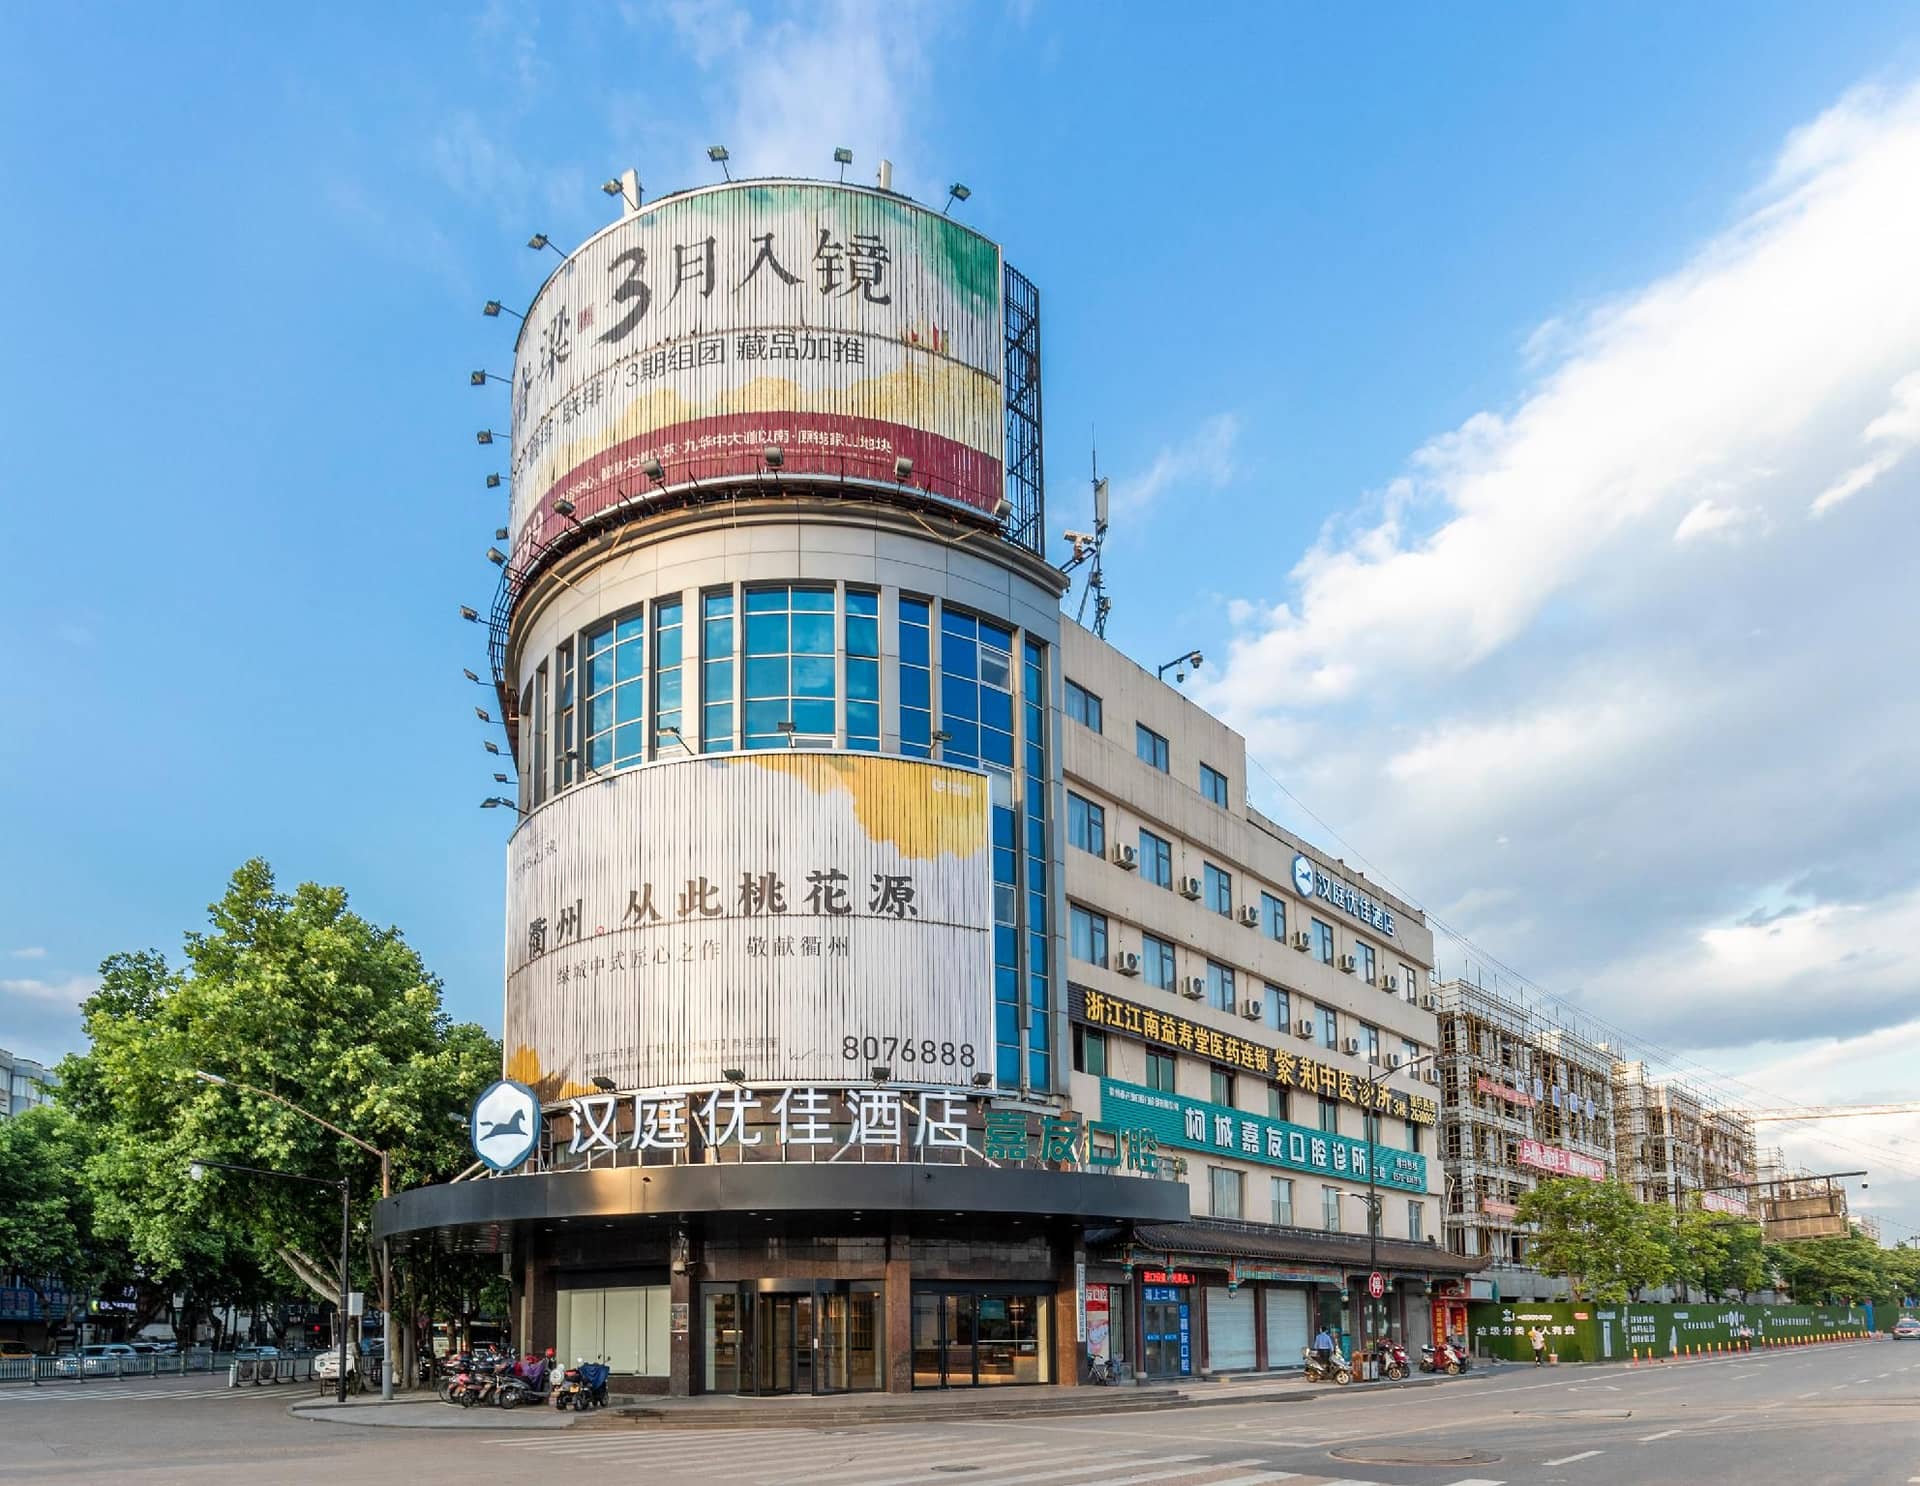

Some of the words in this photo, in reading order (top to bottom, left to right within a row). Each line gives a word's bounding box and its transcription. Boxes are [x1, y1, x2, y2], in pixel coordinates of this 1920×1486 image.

[591, 228, 892, 348] 3月入镜
[736, 331, 866, 366] 藏品加推
[621, 867, 919, 925] 从此桃花源
[1315, 870, 1395, 938] 汉庭优佳酒店
[746, 934, 849, 959] 敬献衢州
[841, 1034, 977, 1069] 8076888
[1085, 991, 1269, 1073] 浙江江南益寿堂医药连锁
[1274, 1047, 1392, 1114] 紫荆中医诊所
[567, 1086, 970, 1155] 汉庭优佳酒店
[984, 1111, 1159, 1174] 嘉友口腔
[1184, 1106, 1367, 1175] 柯城嘉友口腔诊所
